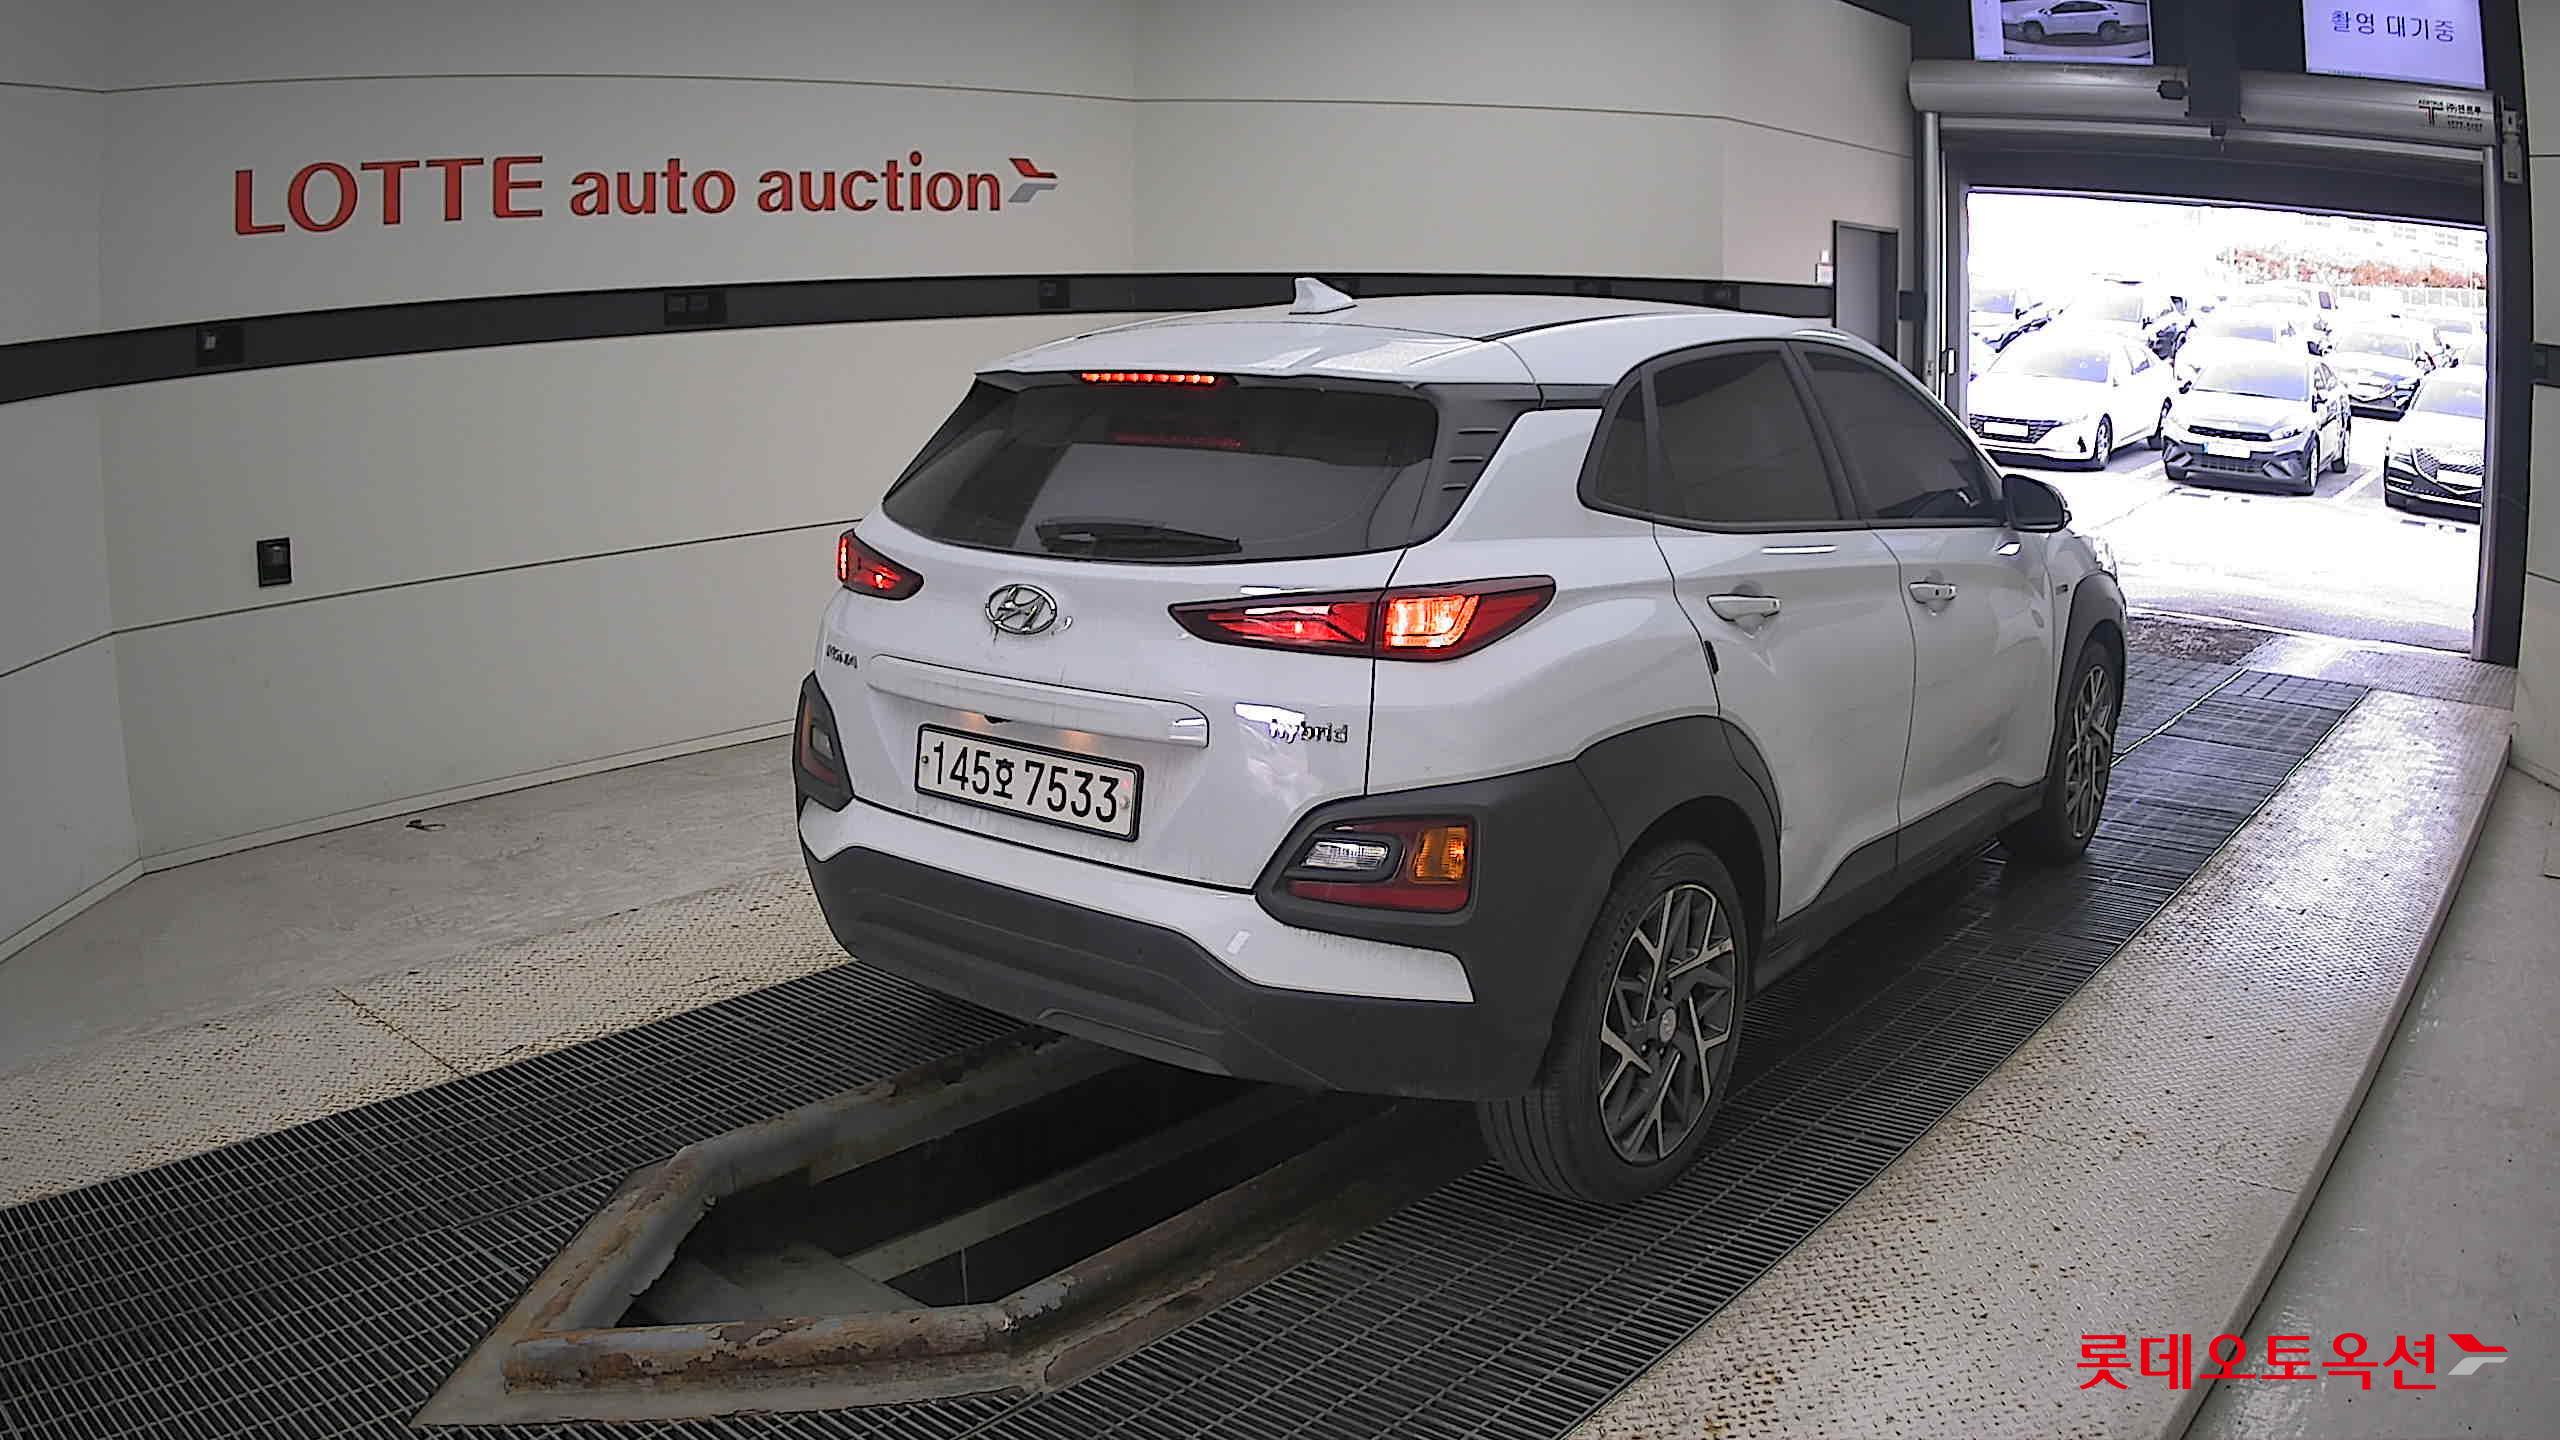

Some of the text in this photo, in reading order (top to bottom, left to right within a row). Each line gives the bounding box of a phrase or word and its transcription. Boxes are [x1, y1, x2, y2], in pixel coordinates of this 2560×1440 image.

[2386, 15, 2455, 43] 대기중
[234, 151, 1002, 236] LOTTE auto auction
[932, 741, 1121, 824] 145호 7533
